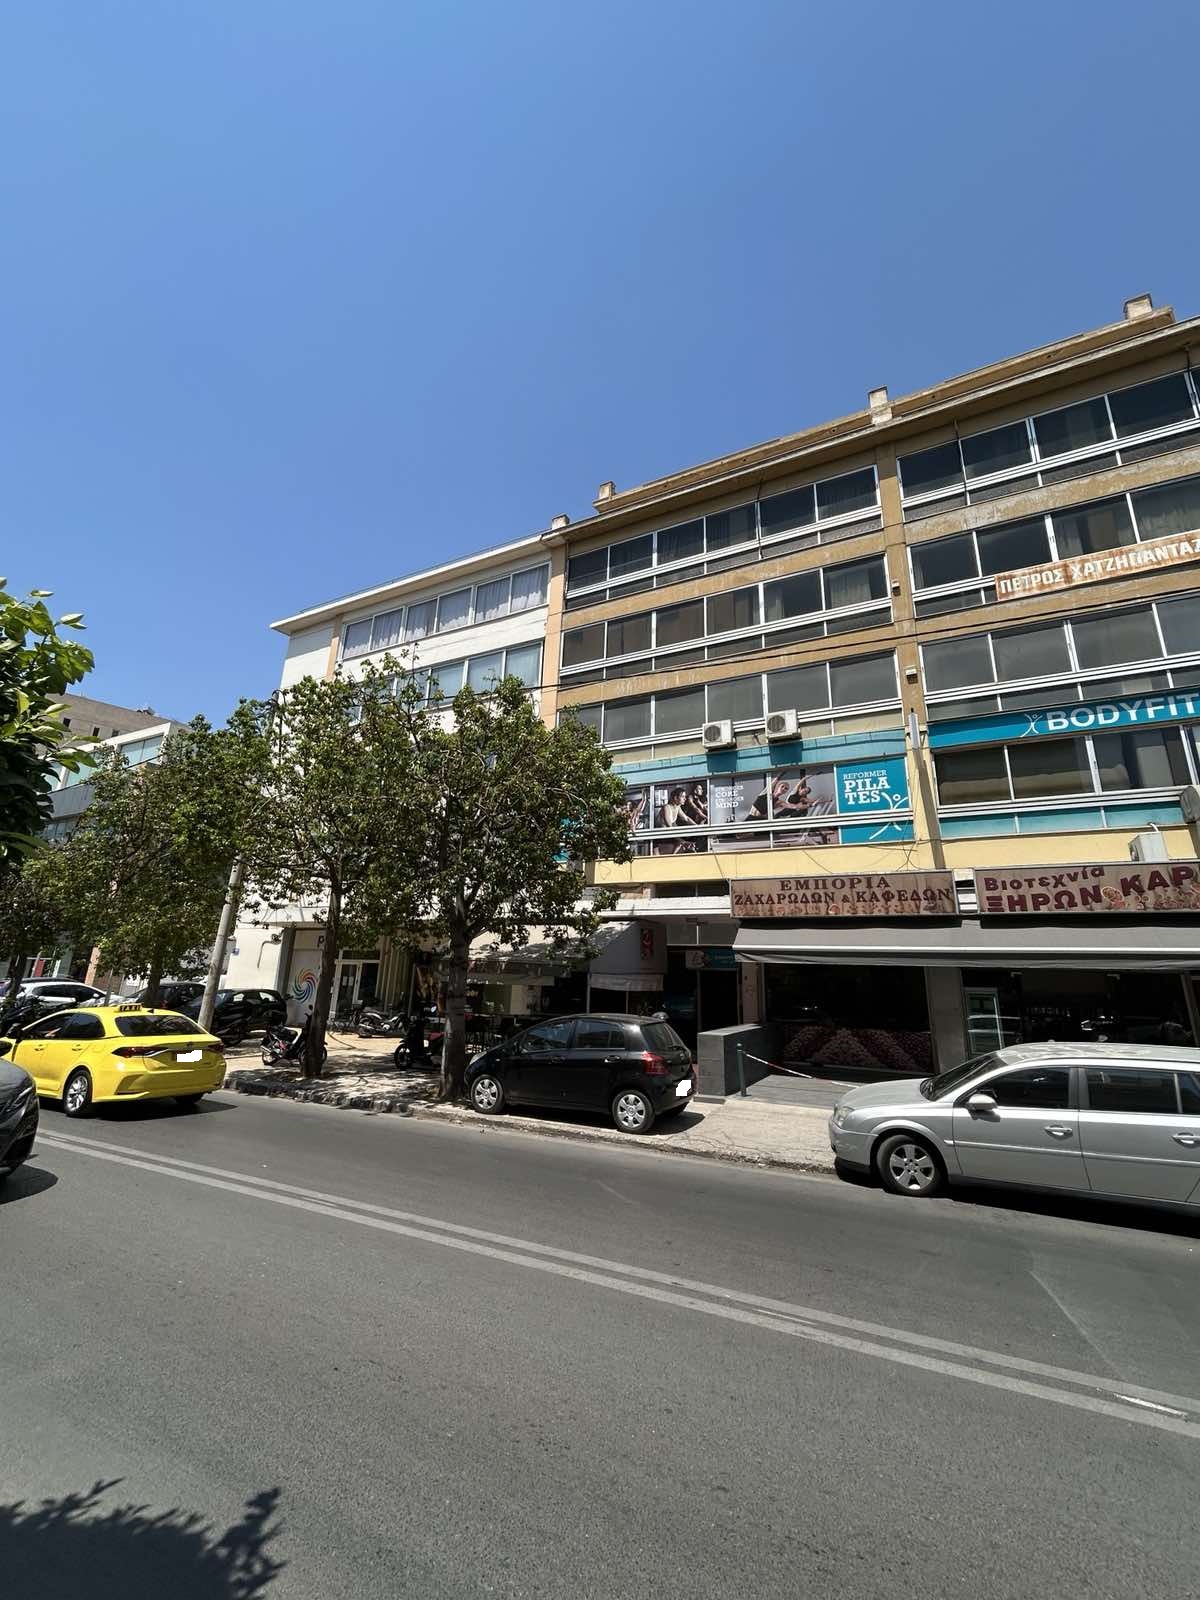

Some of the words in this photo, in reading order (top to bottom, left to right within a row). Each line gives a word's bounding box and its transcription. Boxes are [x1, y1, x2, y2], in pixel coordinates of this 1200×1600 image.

[1000, 568, 1064, 594] ΠΕΤΡΟΣ
[1047, 693, 1199, 731] BODYFIT
[843, 769, 887, 780] REFORMER
[844, 777, 891, 793] PILA
[715, 801, 739, 809] MIND
[845, 790, 881, 805] TES
[780, 876, 891, 891] ΕΜΠΟΡΙΑ
[984, 866, 1105, 891] Βιοτεχνία
[734, 891, 835, 906] ΖΑΧΑΡΩΔΩΝ
[841, 894, 852, 904] &
[856, 888, 950, 905] ΚΑΦΕΔΩΝ
[986, 885, 1104, 912] ΞΗΡΩΝ
[1120, 866, 1200, 897] ΚΑΡ
[120, 1004, 141, 1012] TAXI
